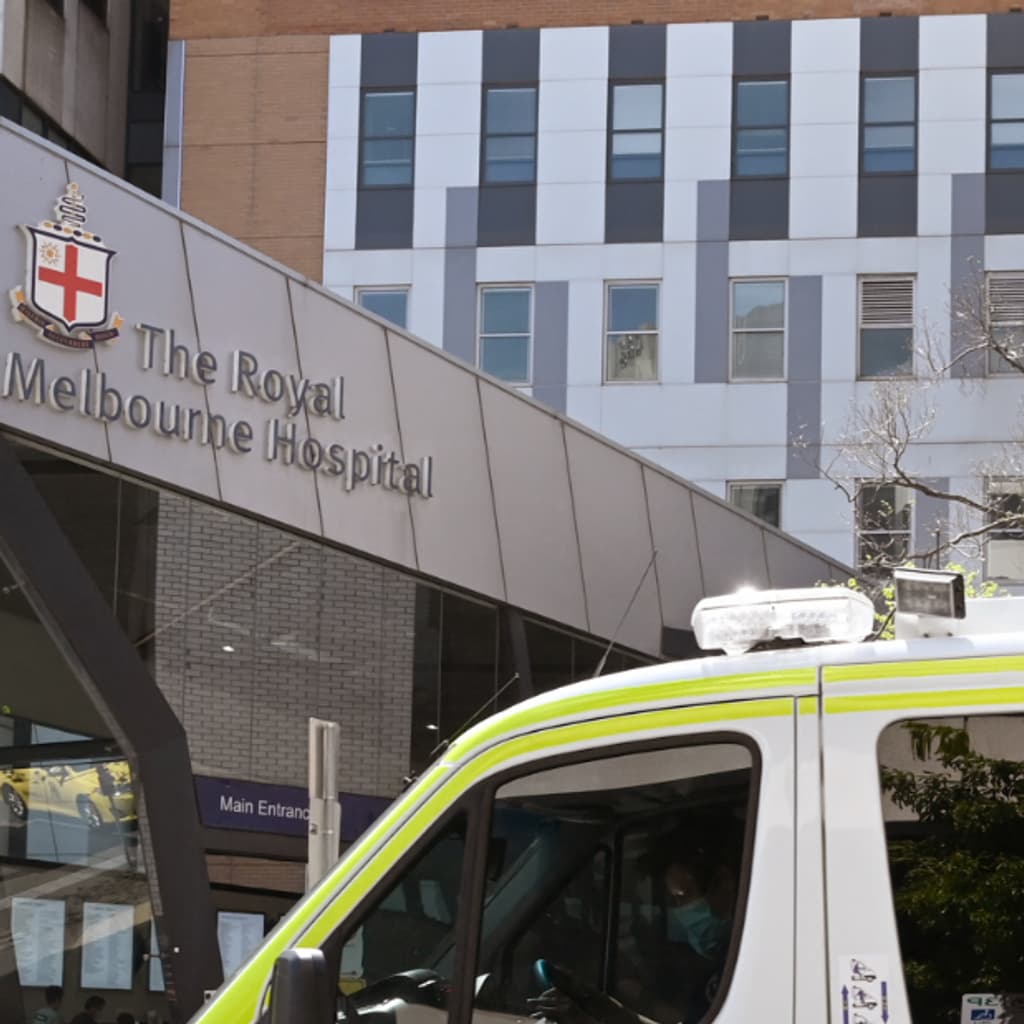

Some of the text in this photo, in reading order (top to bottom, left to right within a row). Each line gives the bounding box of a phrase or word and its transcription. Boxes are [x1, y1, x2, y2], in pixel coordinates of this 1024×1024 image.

[136, 322, 345, 421] The Royal
[1, 351, 433, 499] Melbourne Hospital
[219, 795, 310, 820] Main Entranc
